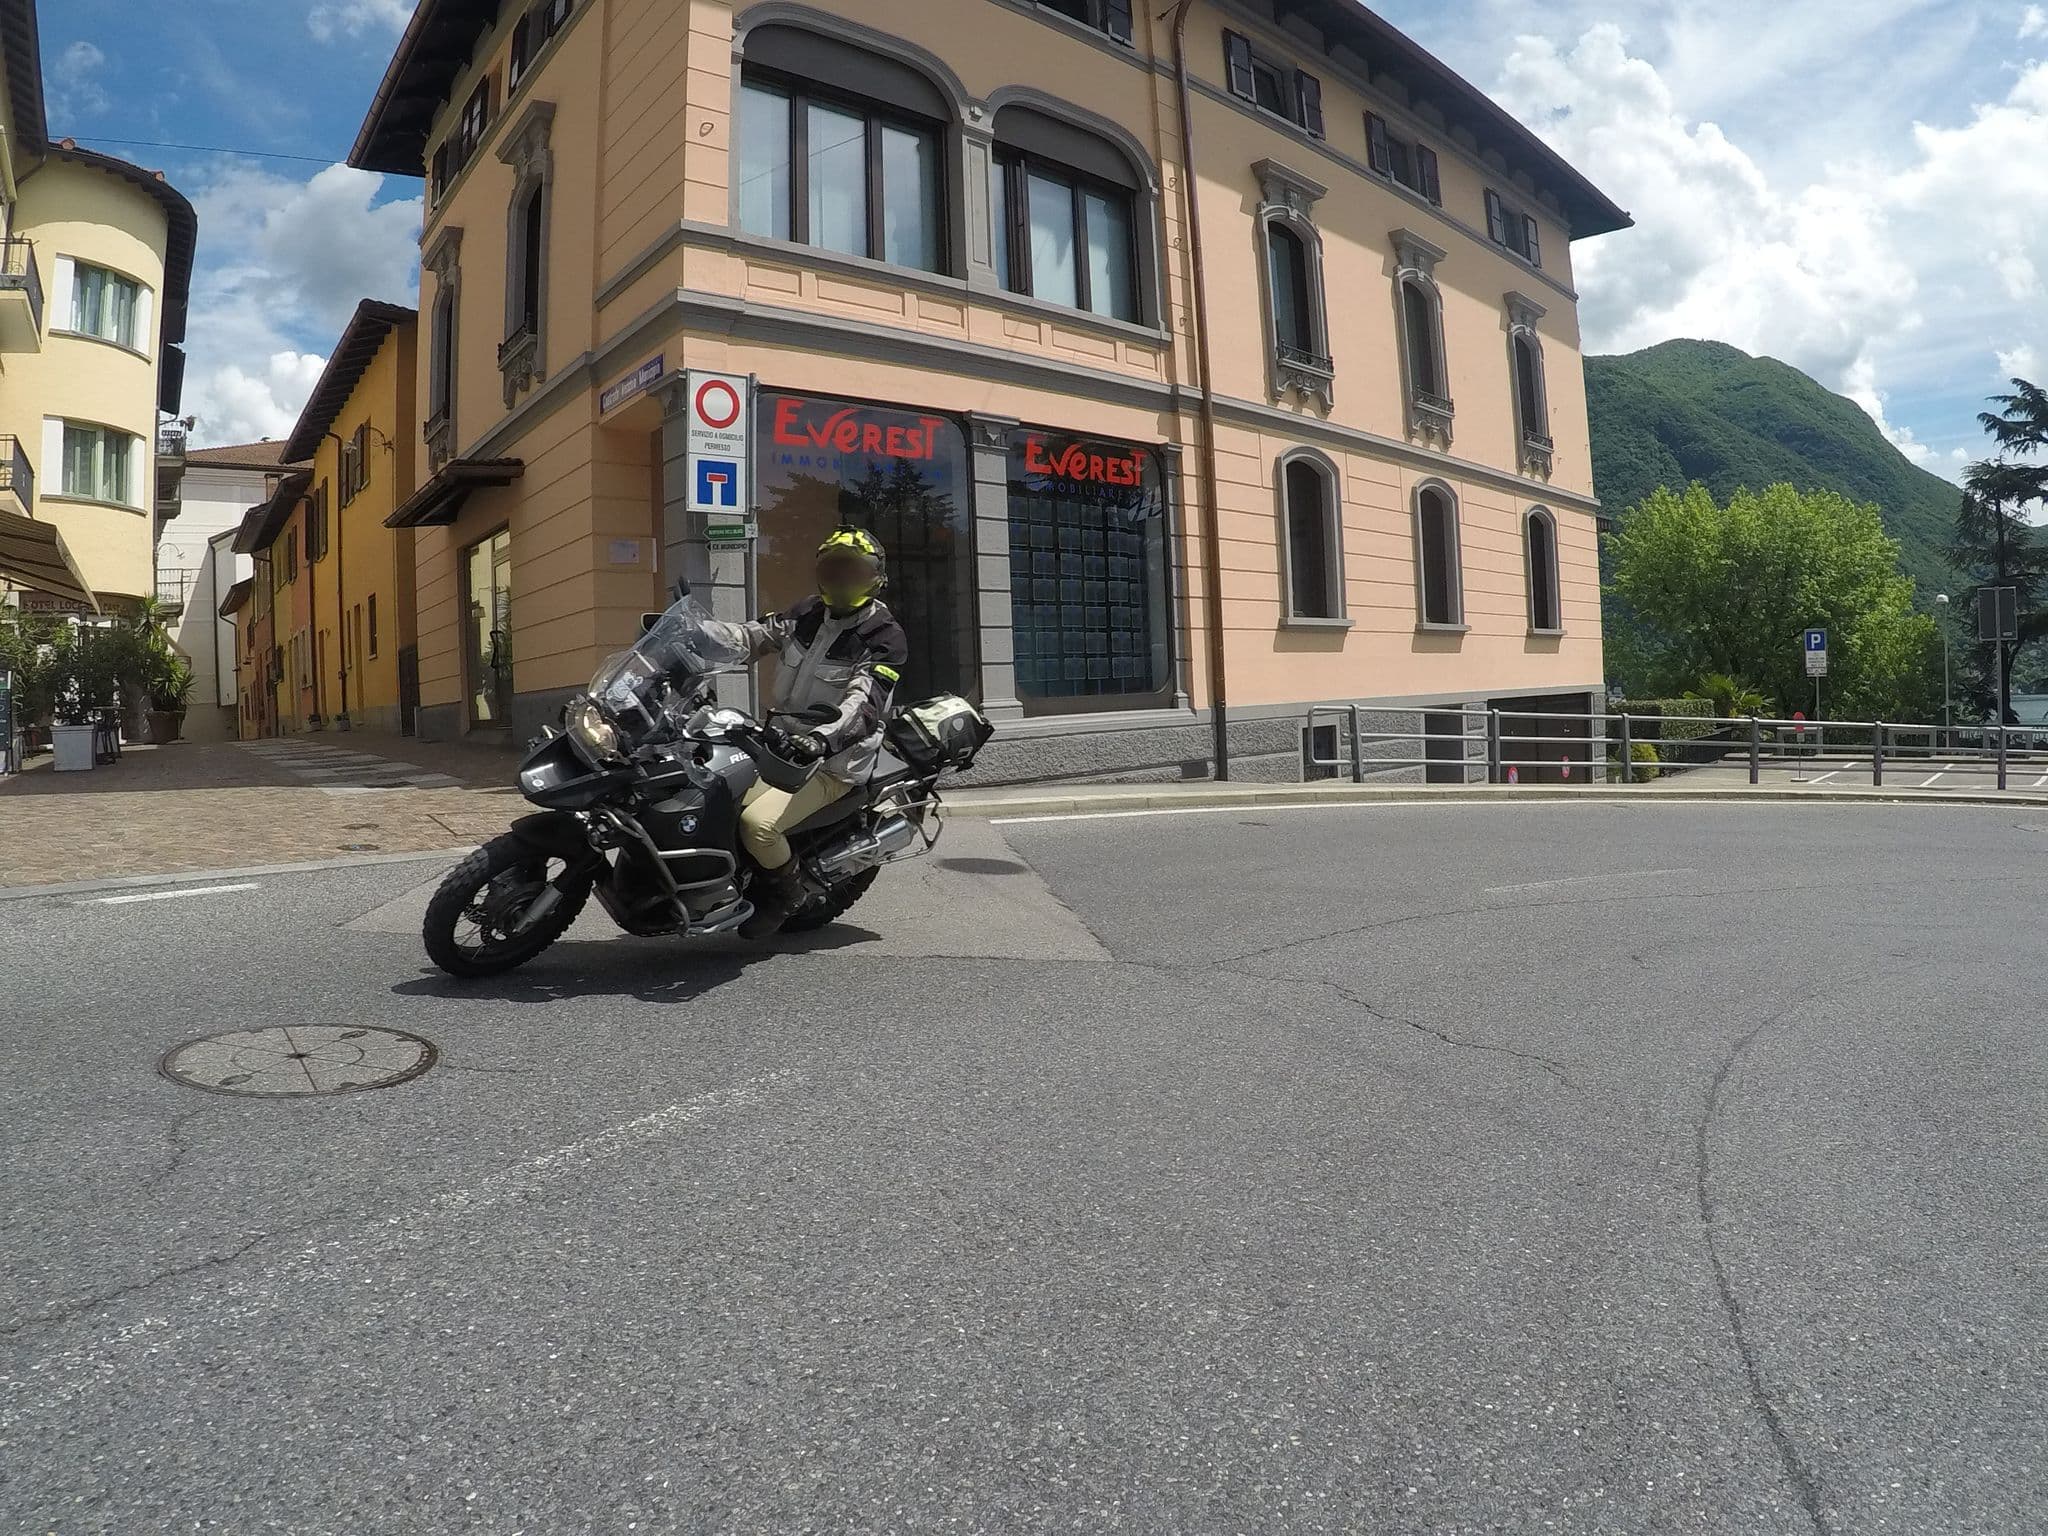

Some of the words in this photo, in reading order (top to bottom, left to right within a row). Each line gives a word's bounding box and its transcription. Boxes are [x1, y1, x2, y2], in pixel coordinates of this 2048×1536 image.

[691, 429, 714, 438] SERVIZIO
[719, 433, 744, 441] DOMICILIO
[704, 442, 731, 451] PERMESSO
[23, 600, 56, 610] HOTEL
[1811, 633, 1821, 649] P
